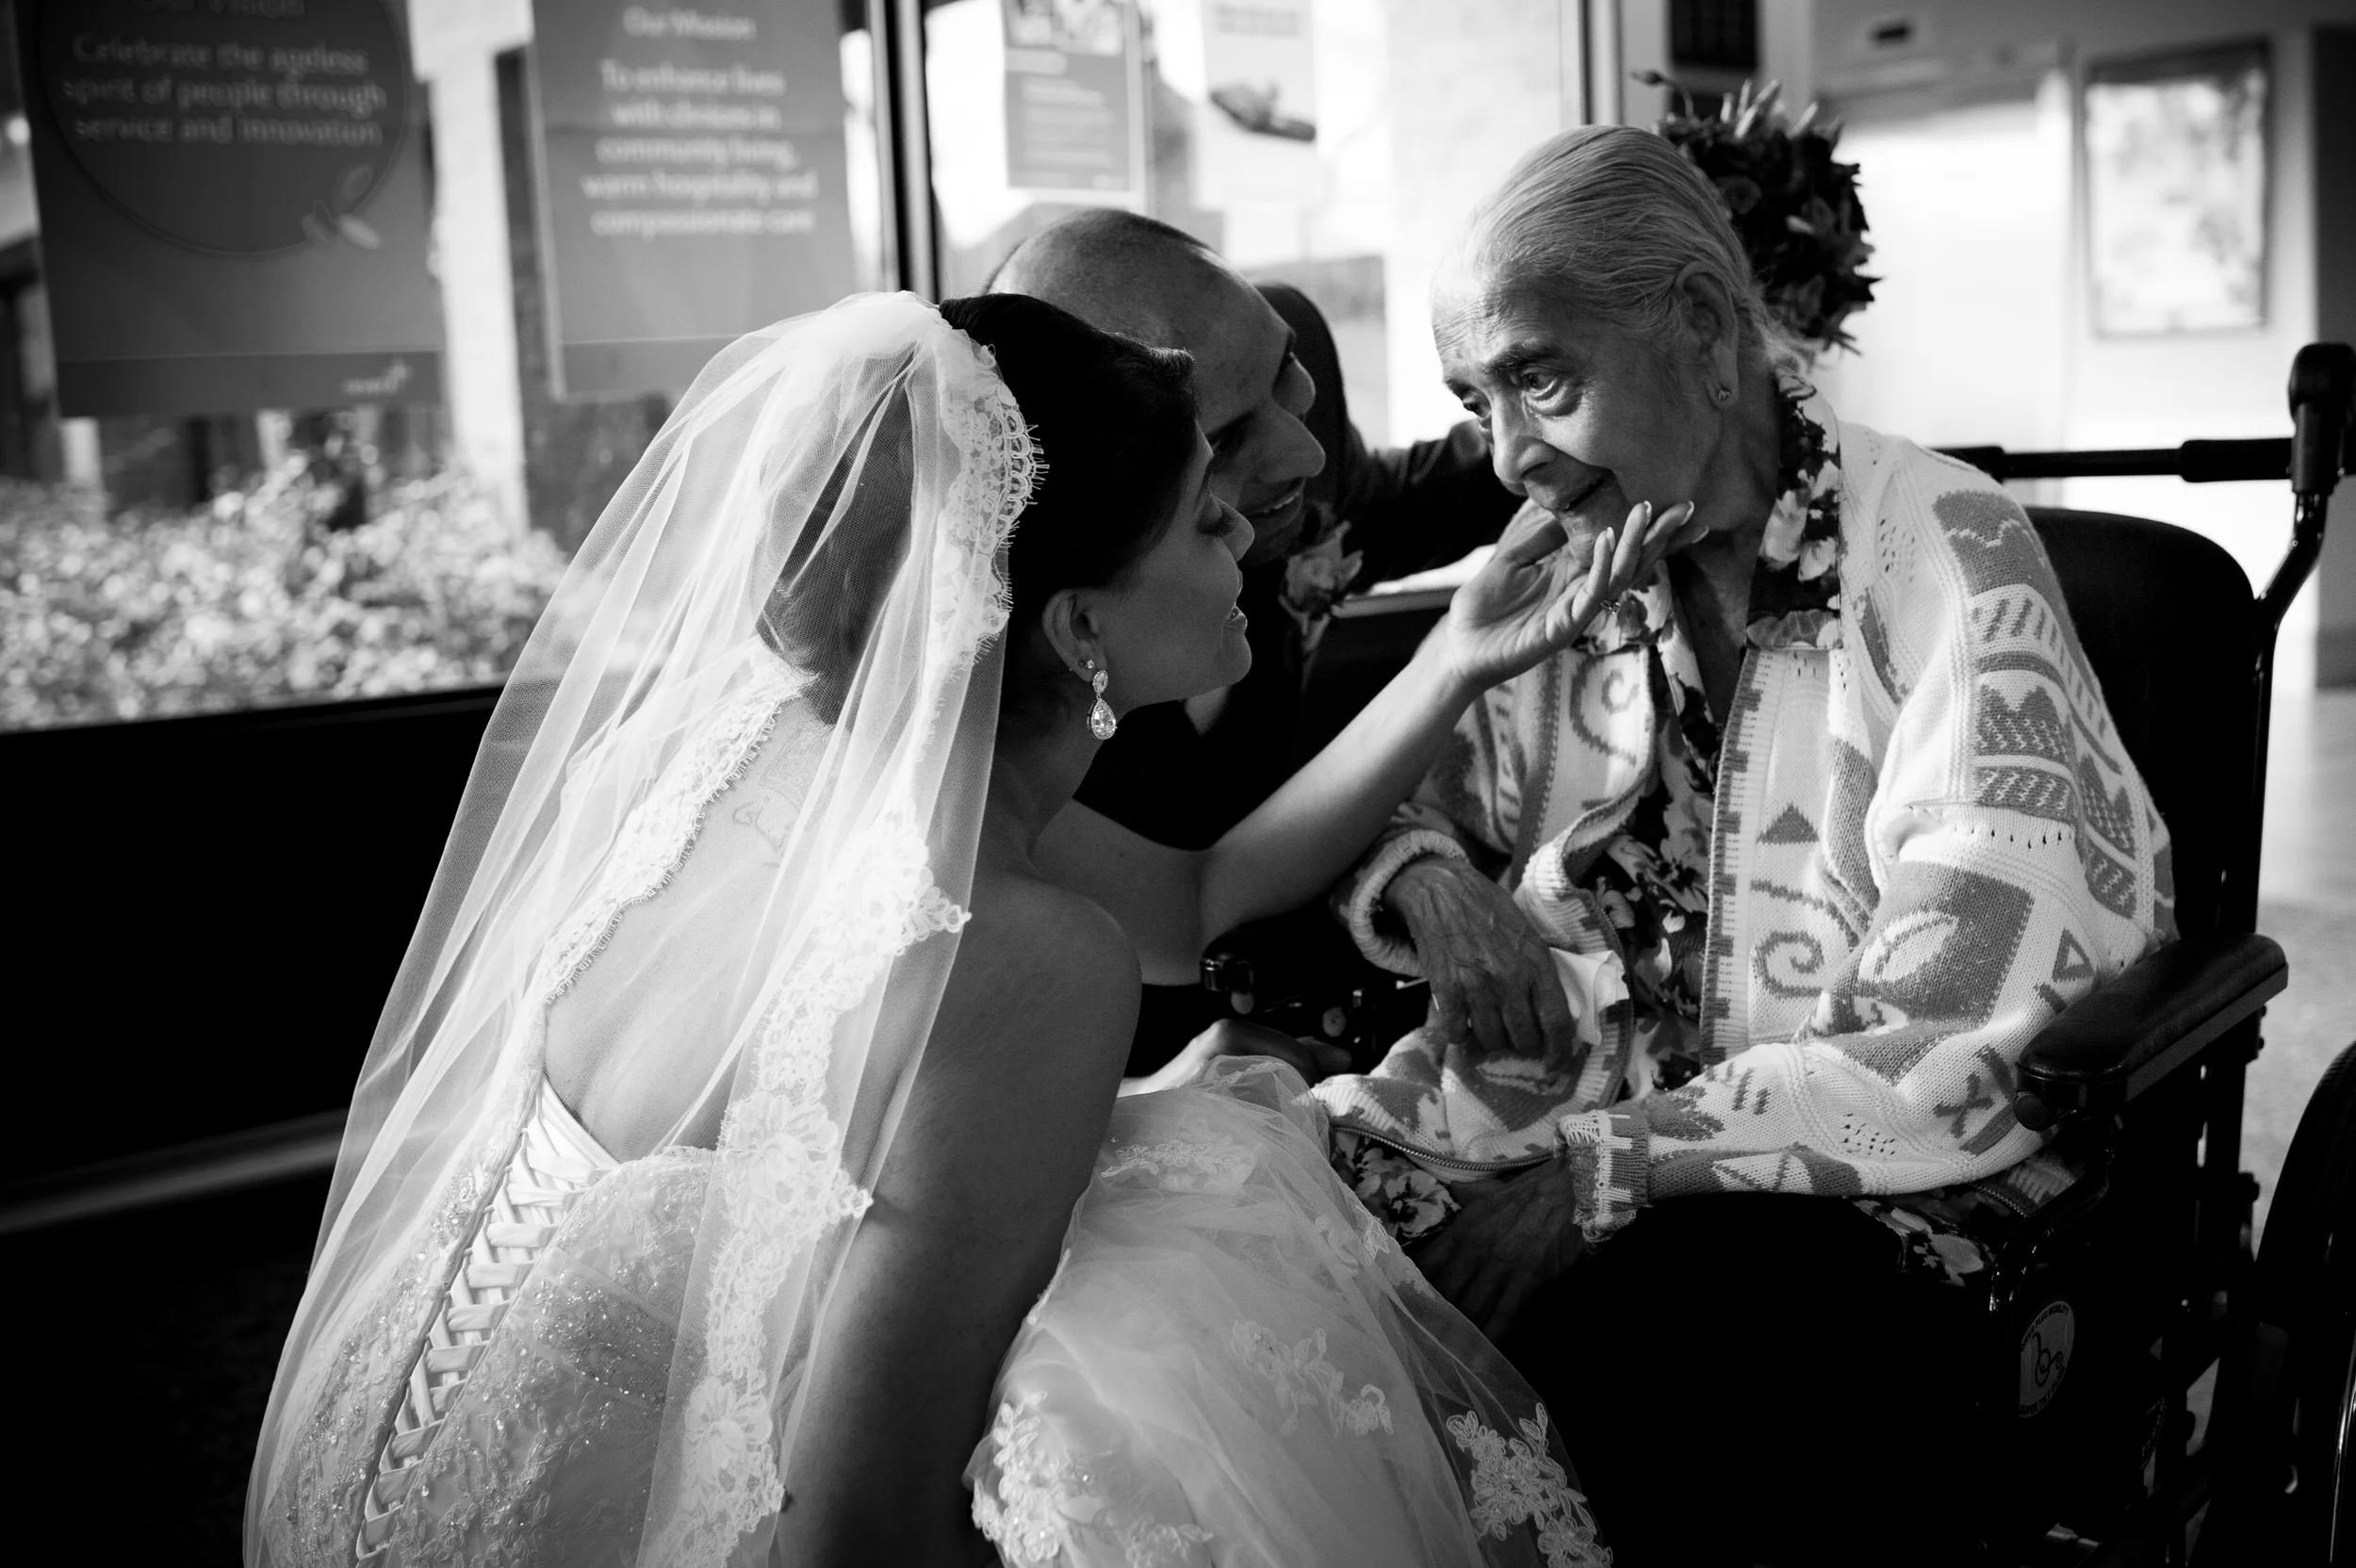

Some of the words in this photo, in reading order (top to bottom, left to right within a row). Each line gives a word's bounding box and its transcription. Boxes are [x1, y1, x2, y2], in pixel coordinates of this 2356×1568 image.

[623, 6, 664, 37] Our
[670, 8, 756, 40] Mission
[73, 32, 212, 70] Celebrate
[217, 41, 264, 71] the
[270, 41, 368, 81] ageless
[600, 58, 633, 92] To
[635, 62, 728, 94] enhance
[729, 63, 787, 96] lives
[63, 77, 136, 110] spirit
[140, 73, 173, 105] of
[177, 77, 272, 114] people
[275, 78, 386, 120] through
[610, 97, 663, 128] with
[664, 98, 753, 129] choices
[73, 116, 173, 143] service
[178, 111, 234, 144] and
[237, 115, 383, 147] innovation
[596, 138, 728, 170] community
[580, 173, 649, 201] warm
[652, 169, 771, 206] hospitality
[773, 169, 819, 201] and
[591, 208, 763, 242] compassionate
[2021, 1324, 2035, 1350] OWER
[2035, 1311, 2048, 1327] PLUS
[2049, 1304, 2069, 1315] MOBILITY
